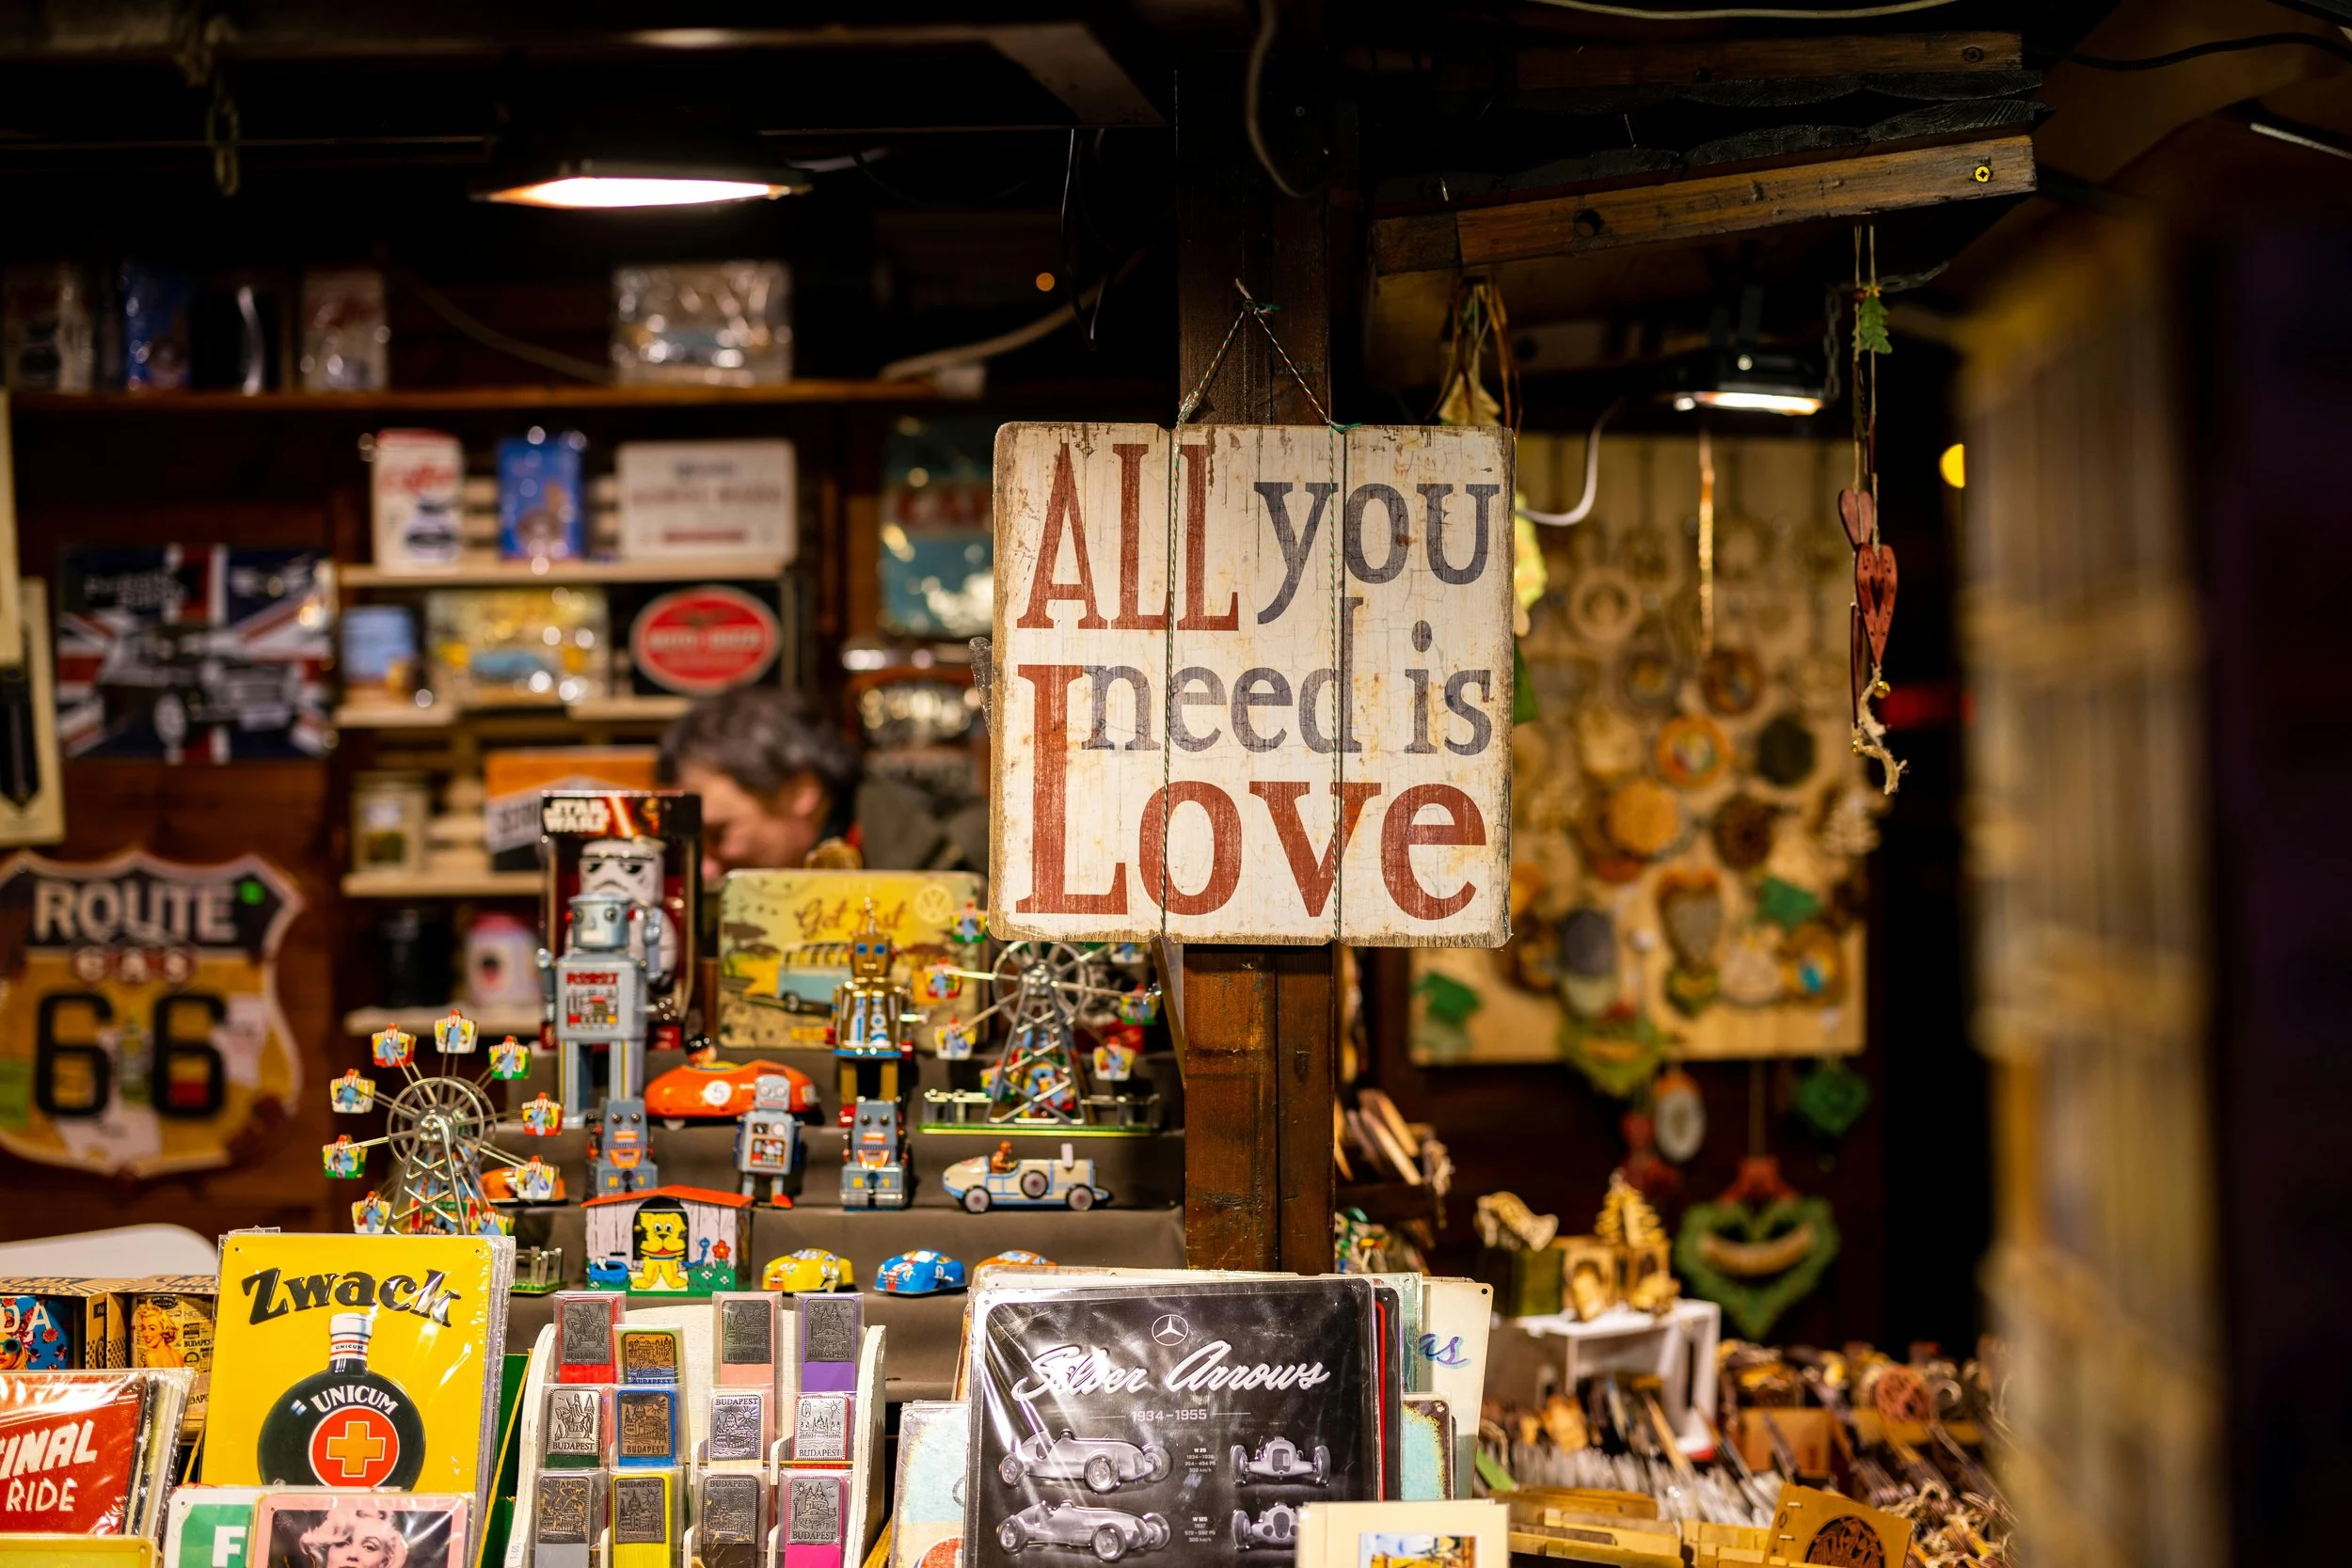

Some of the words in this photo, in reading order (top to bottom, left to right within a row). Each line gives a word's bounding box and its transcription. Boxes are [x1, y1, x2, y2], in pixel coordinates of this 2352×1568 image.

[1080, 596, 1364, 754] need
[1404, 619, 1492, 756] is
[1015, 664, 1486, 921] Love
[549, 799, 607, 816] STAR
[543, 810, 612, 832] WARS
[34, 880, 238, 942] ROUTE
[35, 991, 228, 1118] 66
[241, 1267, 462, 1328] Zwack
[565, 1351, 607, 1360] BUDAPEST
[808, 1351, 850, 1359] BUDAPEST
[1164, 1339, 1331, 1393] Arrows
[310, 1385, 399, 1415] UNICUM
[716, 1398, 758, 1406] BUDAPEST
[552, 1441, 595, 1450] BUDAPEST
[627, 1445, 665, 1454] BUDAPEST
[799, 1449, 842, 1458] BUDAPEST
[618, 1480, 662, 1489] BUDAPEST
[709, 1480, 754, 1489] BUDAPEST
[6, 1477, 78, 1513] RIDE
[792, 1531, 836, 1540] BUDAPEST
